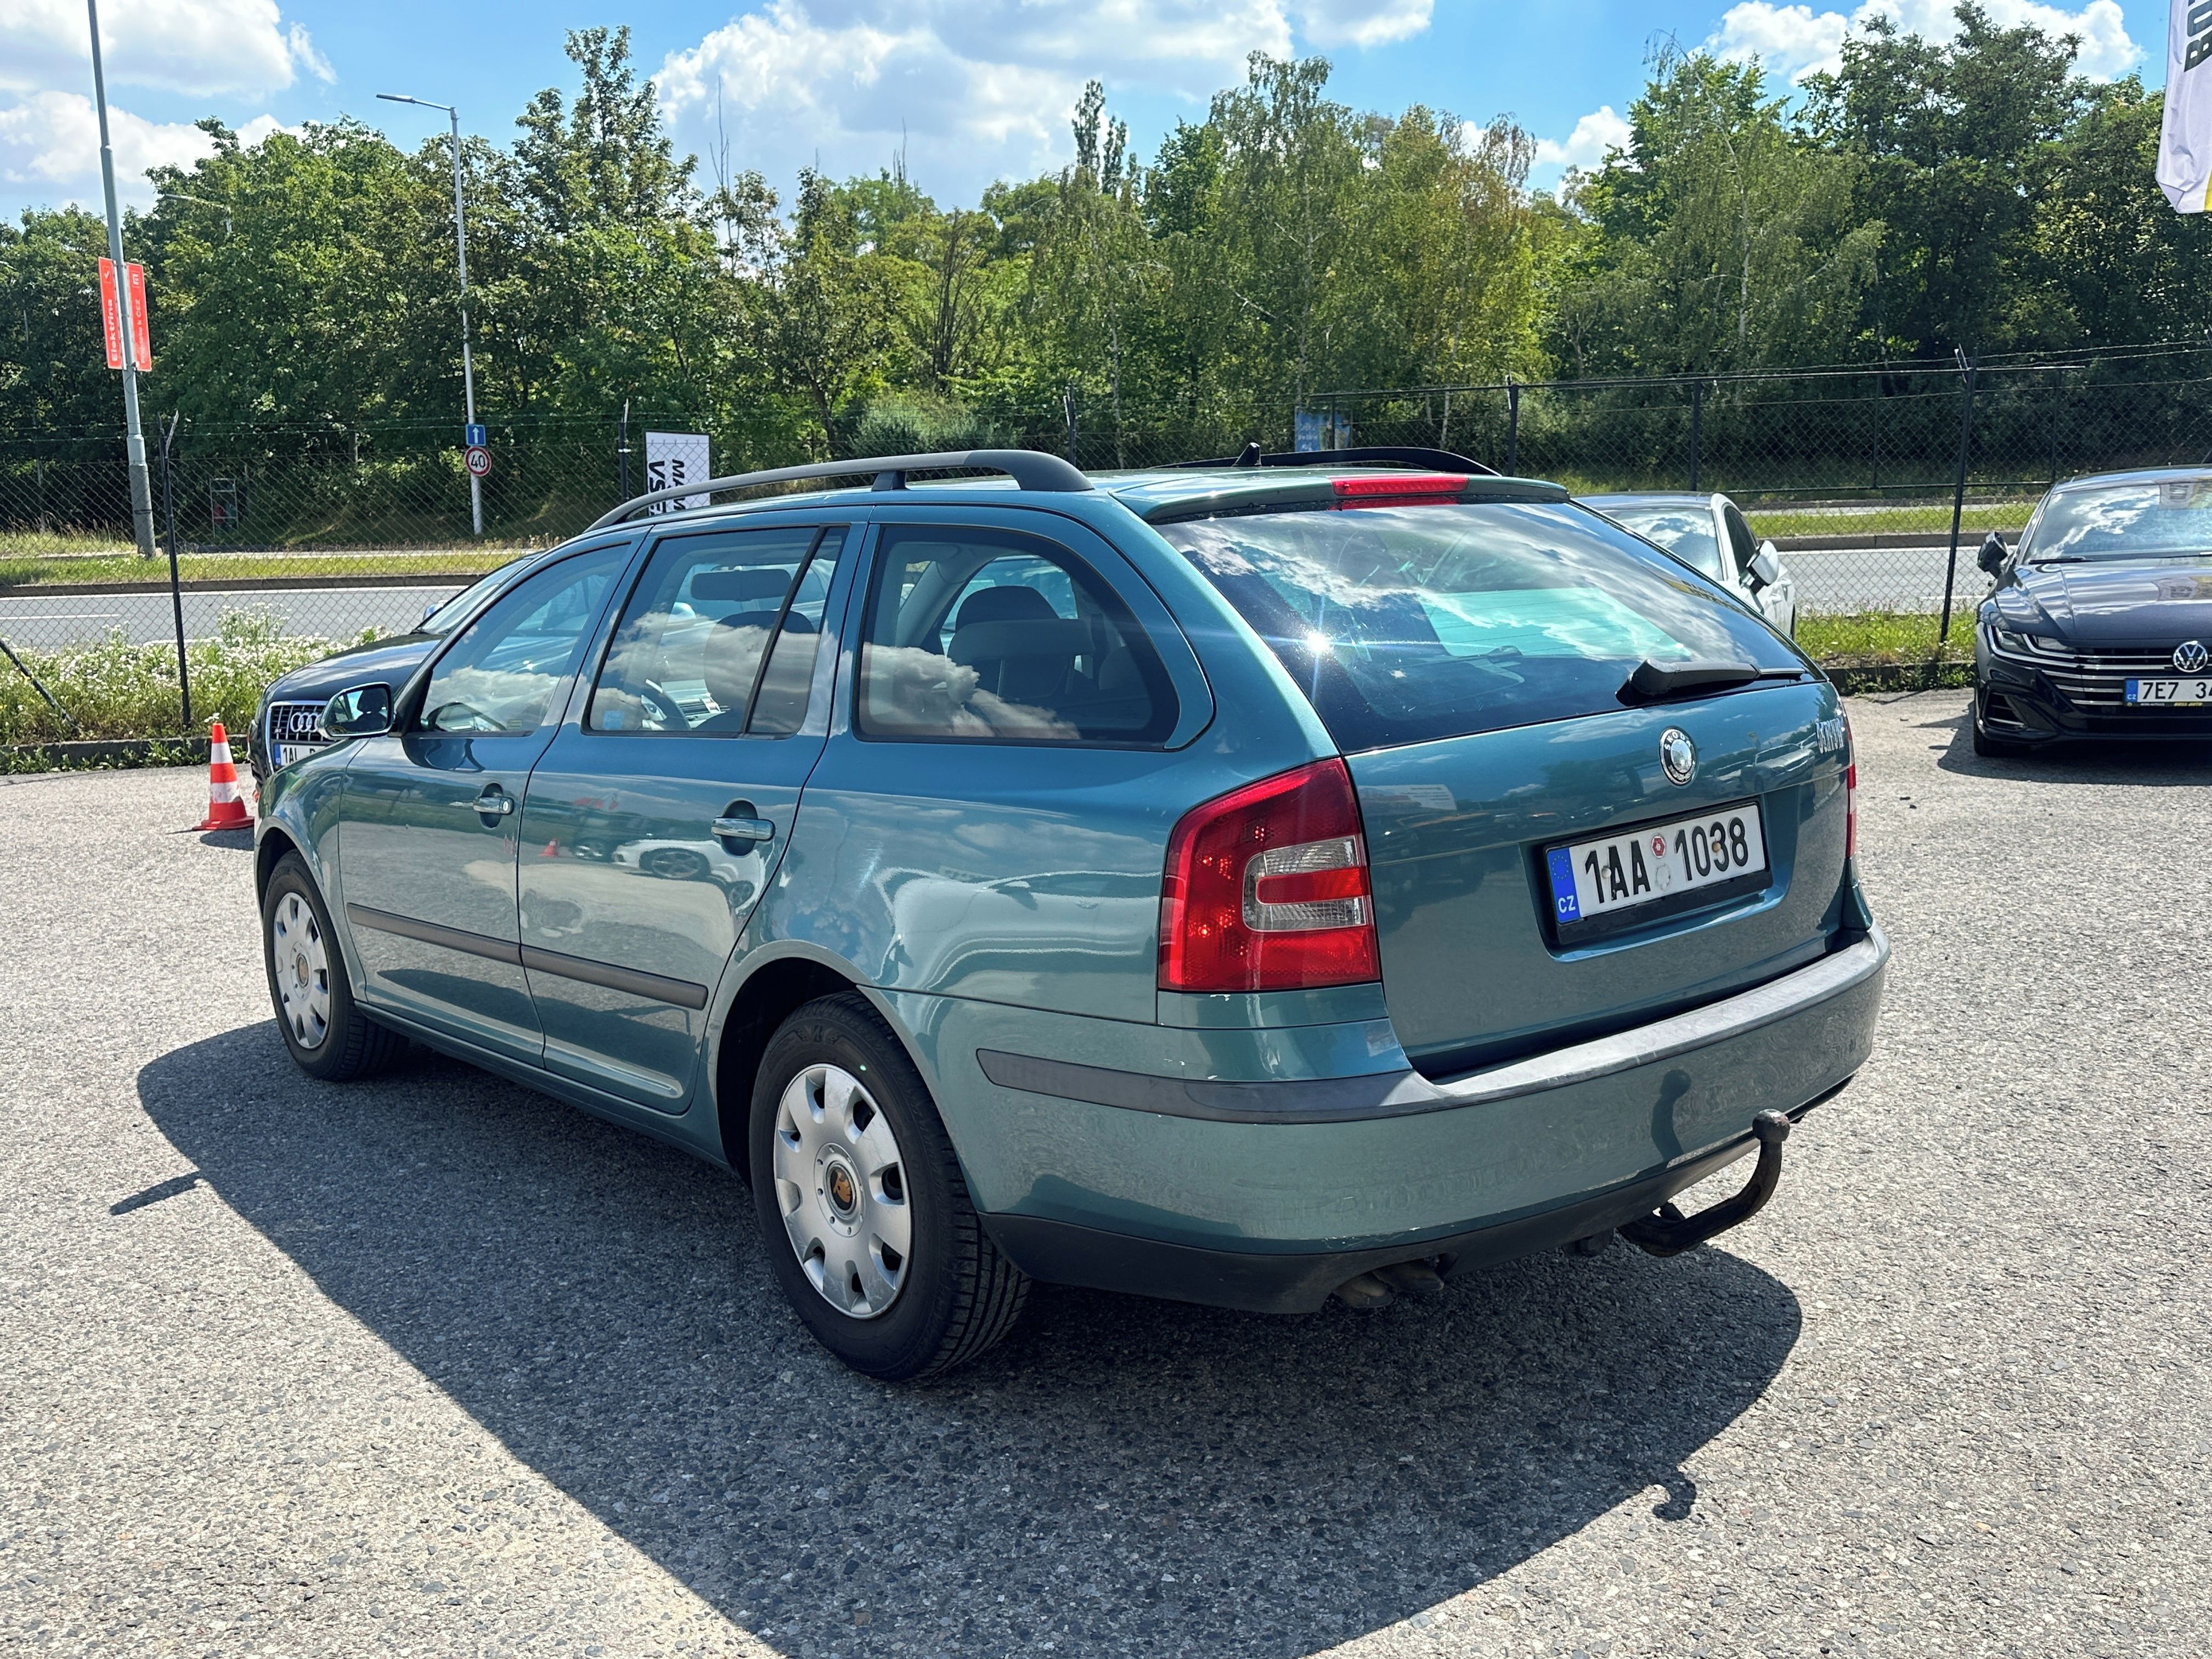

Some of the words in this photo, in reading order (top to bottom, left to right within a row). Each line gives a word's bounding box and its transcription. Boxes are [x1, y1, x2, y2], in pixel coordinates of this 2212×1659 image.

[2183, 0, 2212, 72] BO
[471, 454, 486, 468] 40
[2143, 682, 2179, 699] 7E7
[1584, 839, 1651, 904] 1AA
[1674, 817, 1748, 882] 1038
[1558, 894, 1576, 914] CZ
